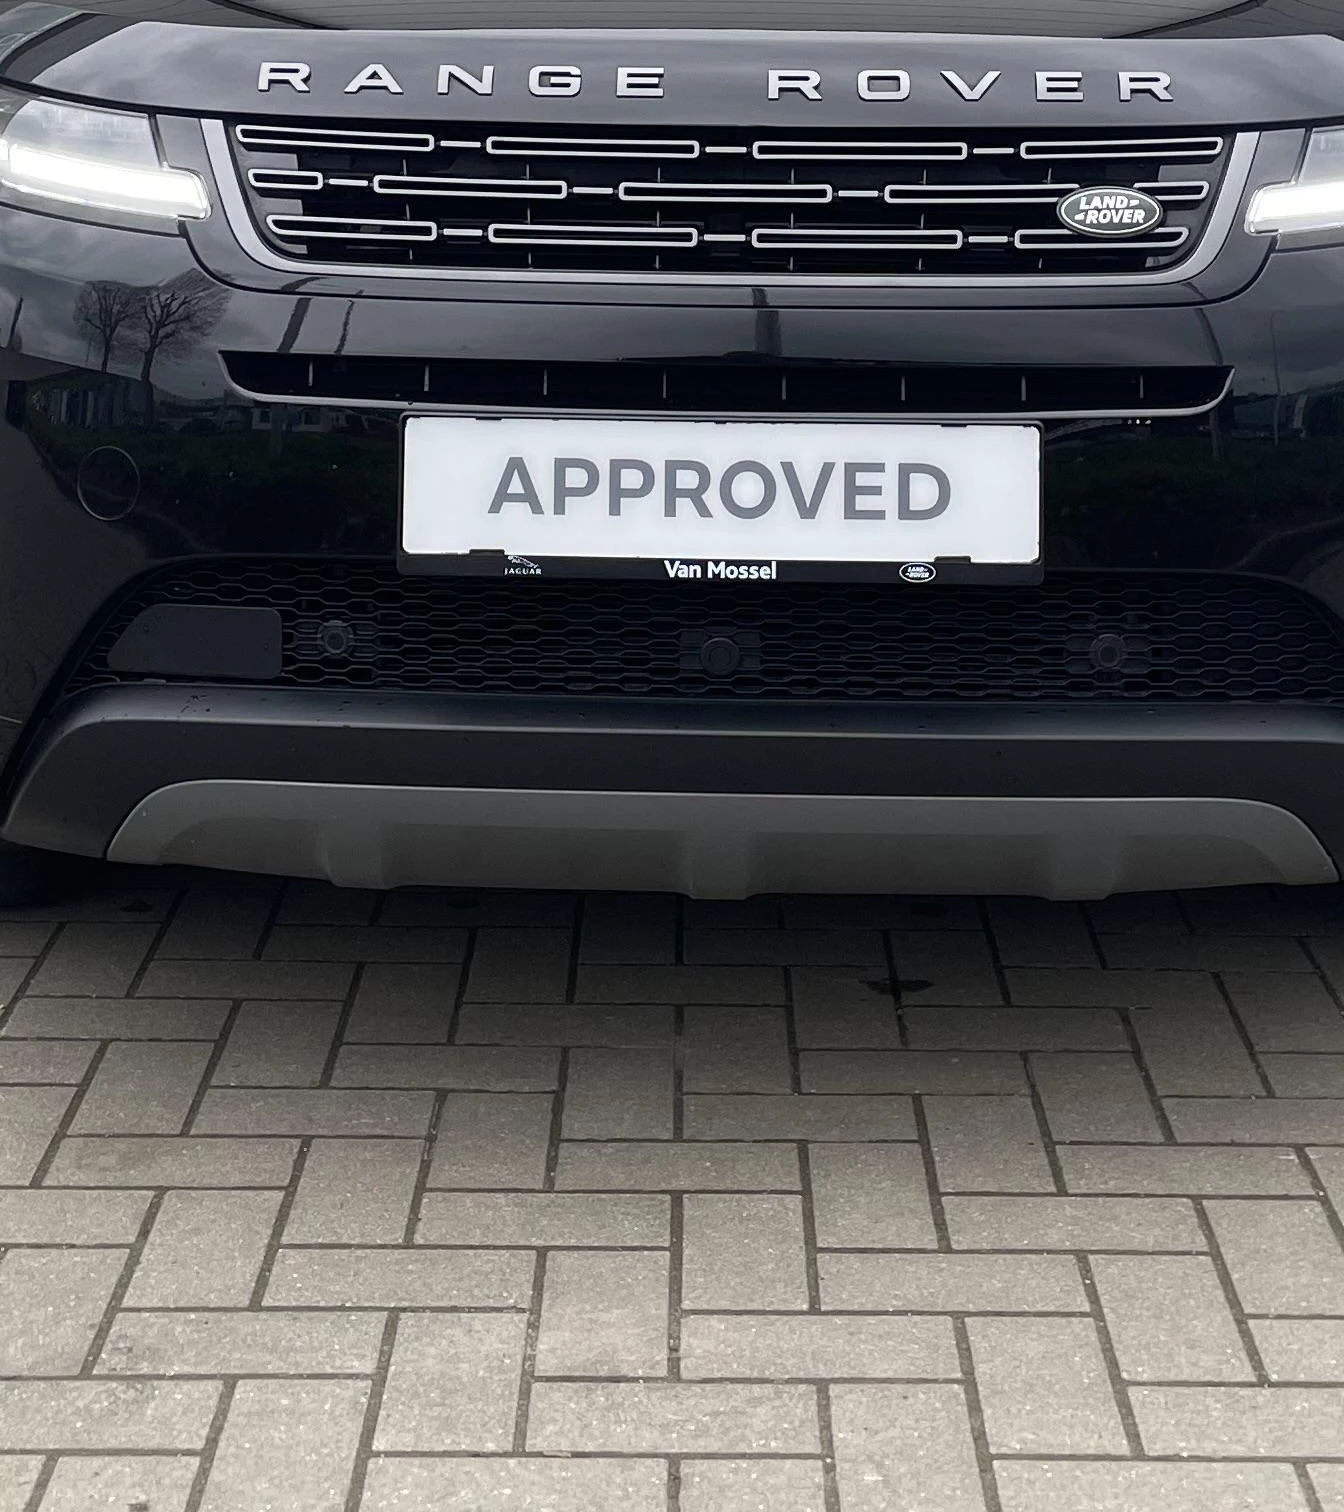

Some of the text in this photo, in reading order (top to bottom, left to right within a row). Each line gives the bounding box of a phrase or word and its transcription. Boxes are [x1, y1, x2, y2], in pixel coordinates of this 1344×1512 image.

[256, 61, 1175, 103] RANGE ROVER
[1079, 195, 1128, 210] LAND
[1085, 208, 1146, 224] ROVER
[487, 456, 952, 521] APPROVED
[503, 567, 542, 576] JAGUAR
[663, 559, 777, 580] Van Mossel
